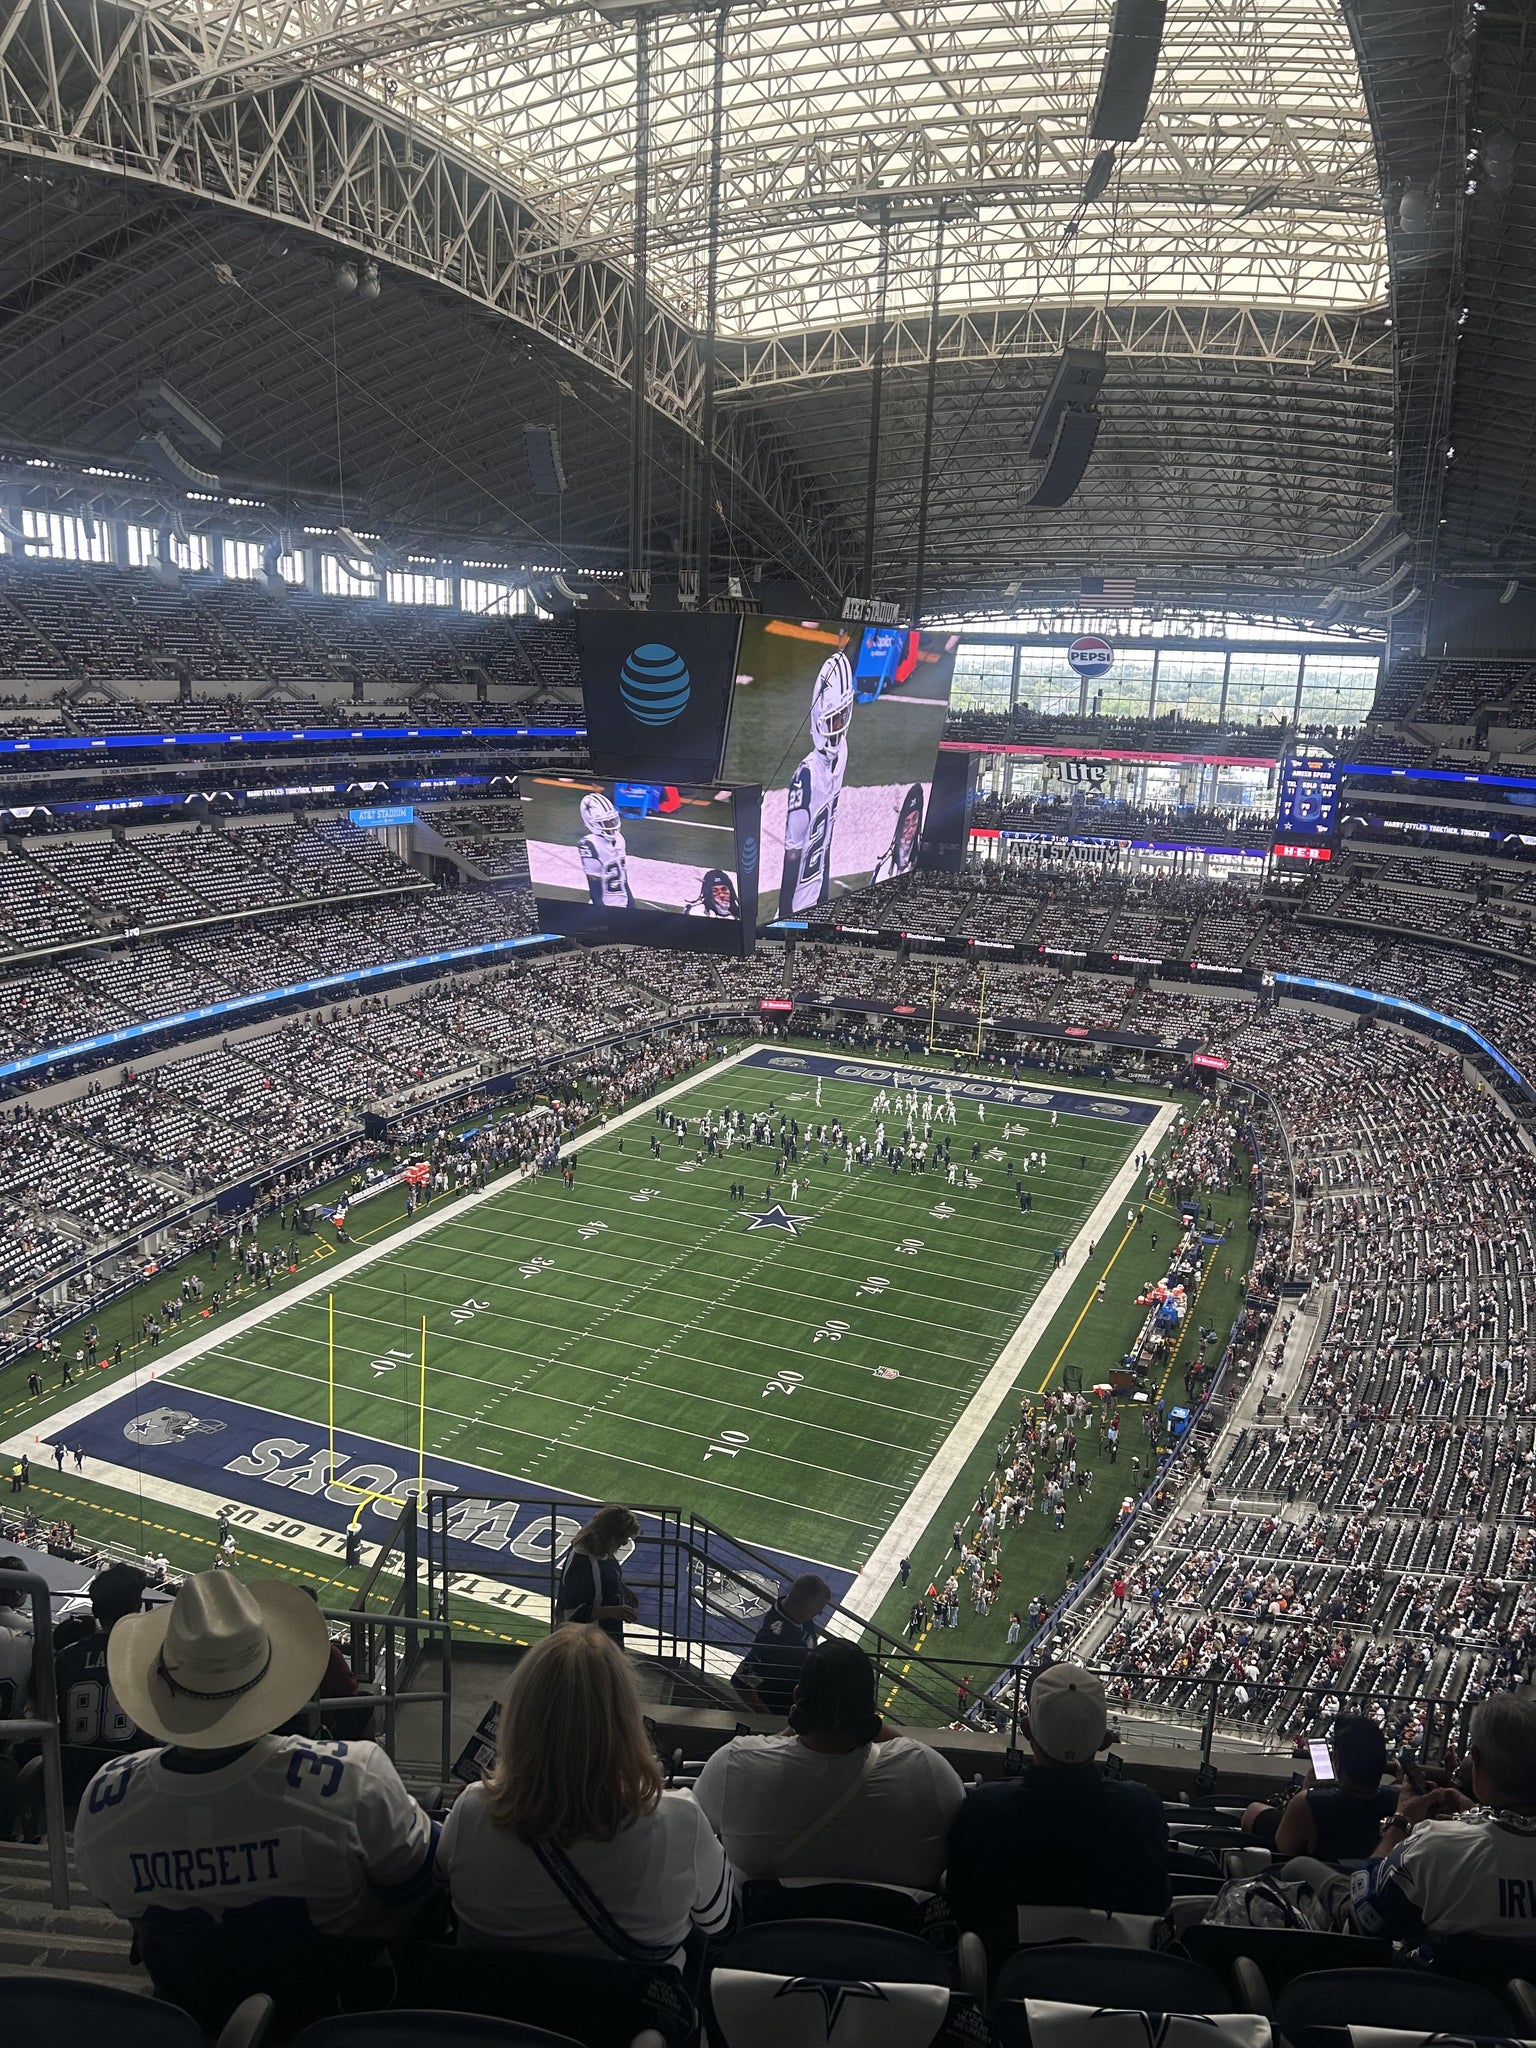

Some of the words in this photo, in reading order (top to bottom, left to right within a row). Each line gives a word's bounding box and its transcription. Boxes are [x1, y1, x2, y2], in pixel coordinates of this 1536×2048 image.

[841, 597, 866, 620] AT&T
[865, 600, 900, 623] STADIUM
[1070, 652, 1110, 662] PEPSI
[1058, 762, 1104, 785] Lite
[359, 810, 376, 820] AT&T
[377, 808, 406, 819] STADIUM
[1010, 842, 1048, 858] AT&T
[1050, 845, 1120, 864] STADIUM
[834, 1065, 1054, 1104] COWBOYS
[630, 1187, 661, 1202] 50
[929, 1204, 955, 1220] 40
[577, 1220, 608, 1237] 40
[895, 1238, 924, 1256] 50
[518, 1256, 554, 1275] 30
[860, 1276, 890, 1294] 40
[450, 1298, 491, 1320] 20
[815, 1320, 850, 1341] 30
[370, 1347, 414, 1372] 10
[766, 1370, 804, 1396] 20
[708, 1430, 750, 1458] 10
[216, 1504, 253, 1526] US
[261, 1517, 306, 1540] OF
[318, 1532, 374, 1558] ALL
[490, 1589, 528, 1608] IT
[84, 1650, 107, 1669] LA
[130, 1838, 280, 1894] DORSETT
